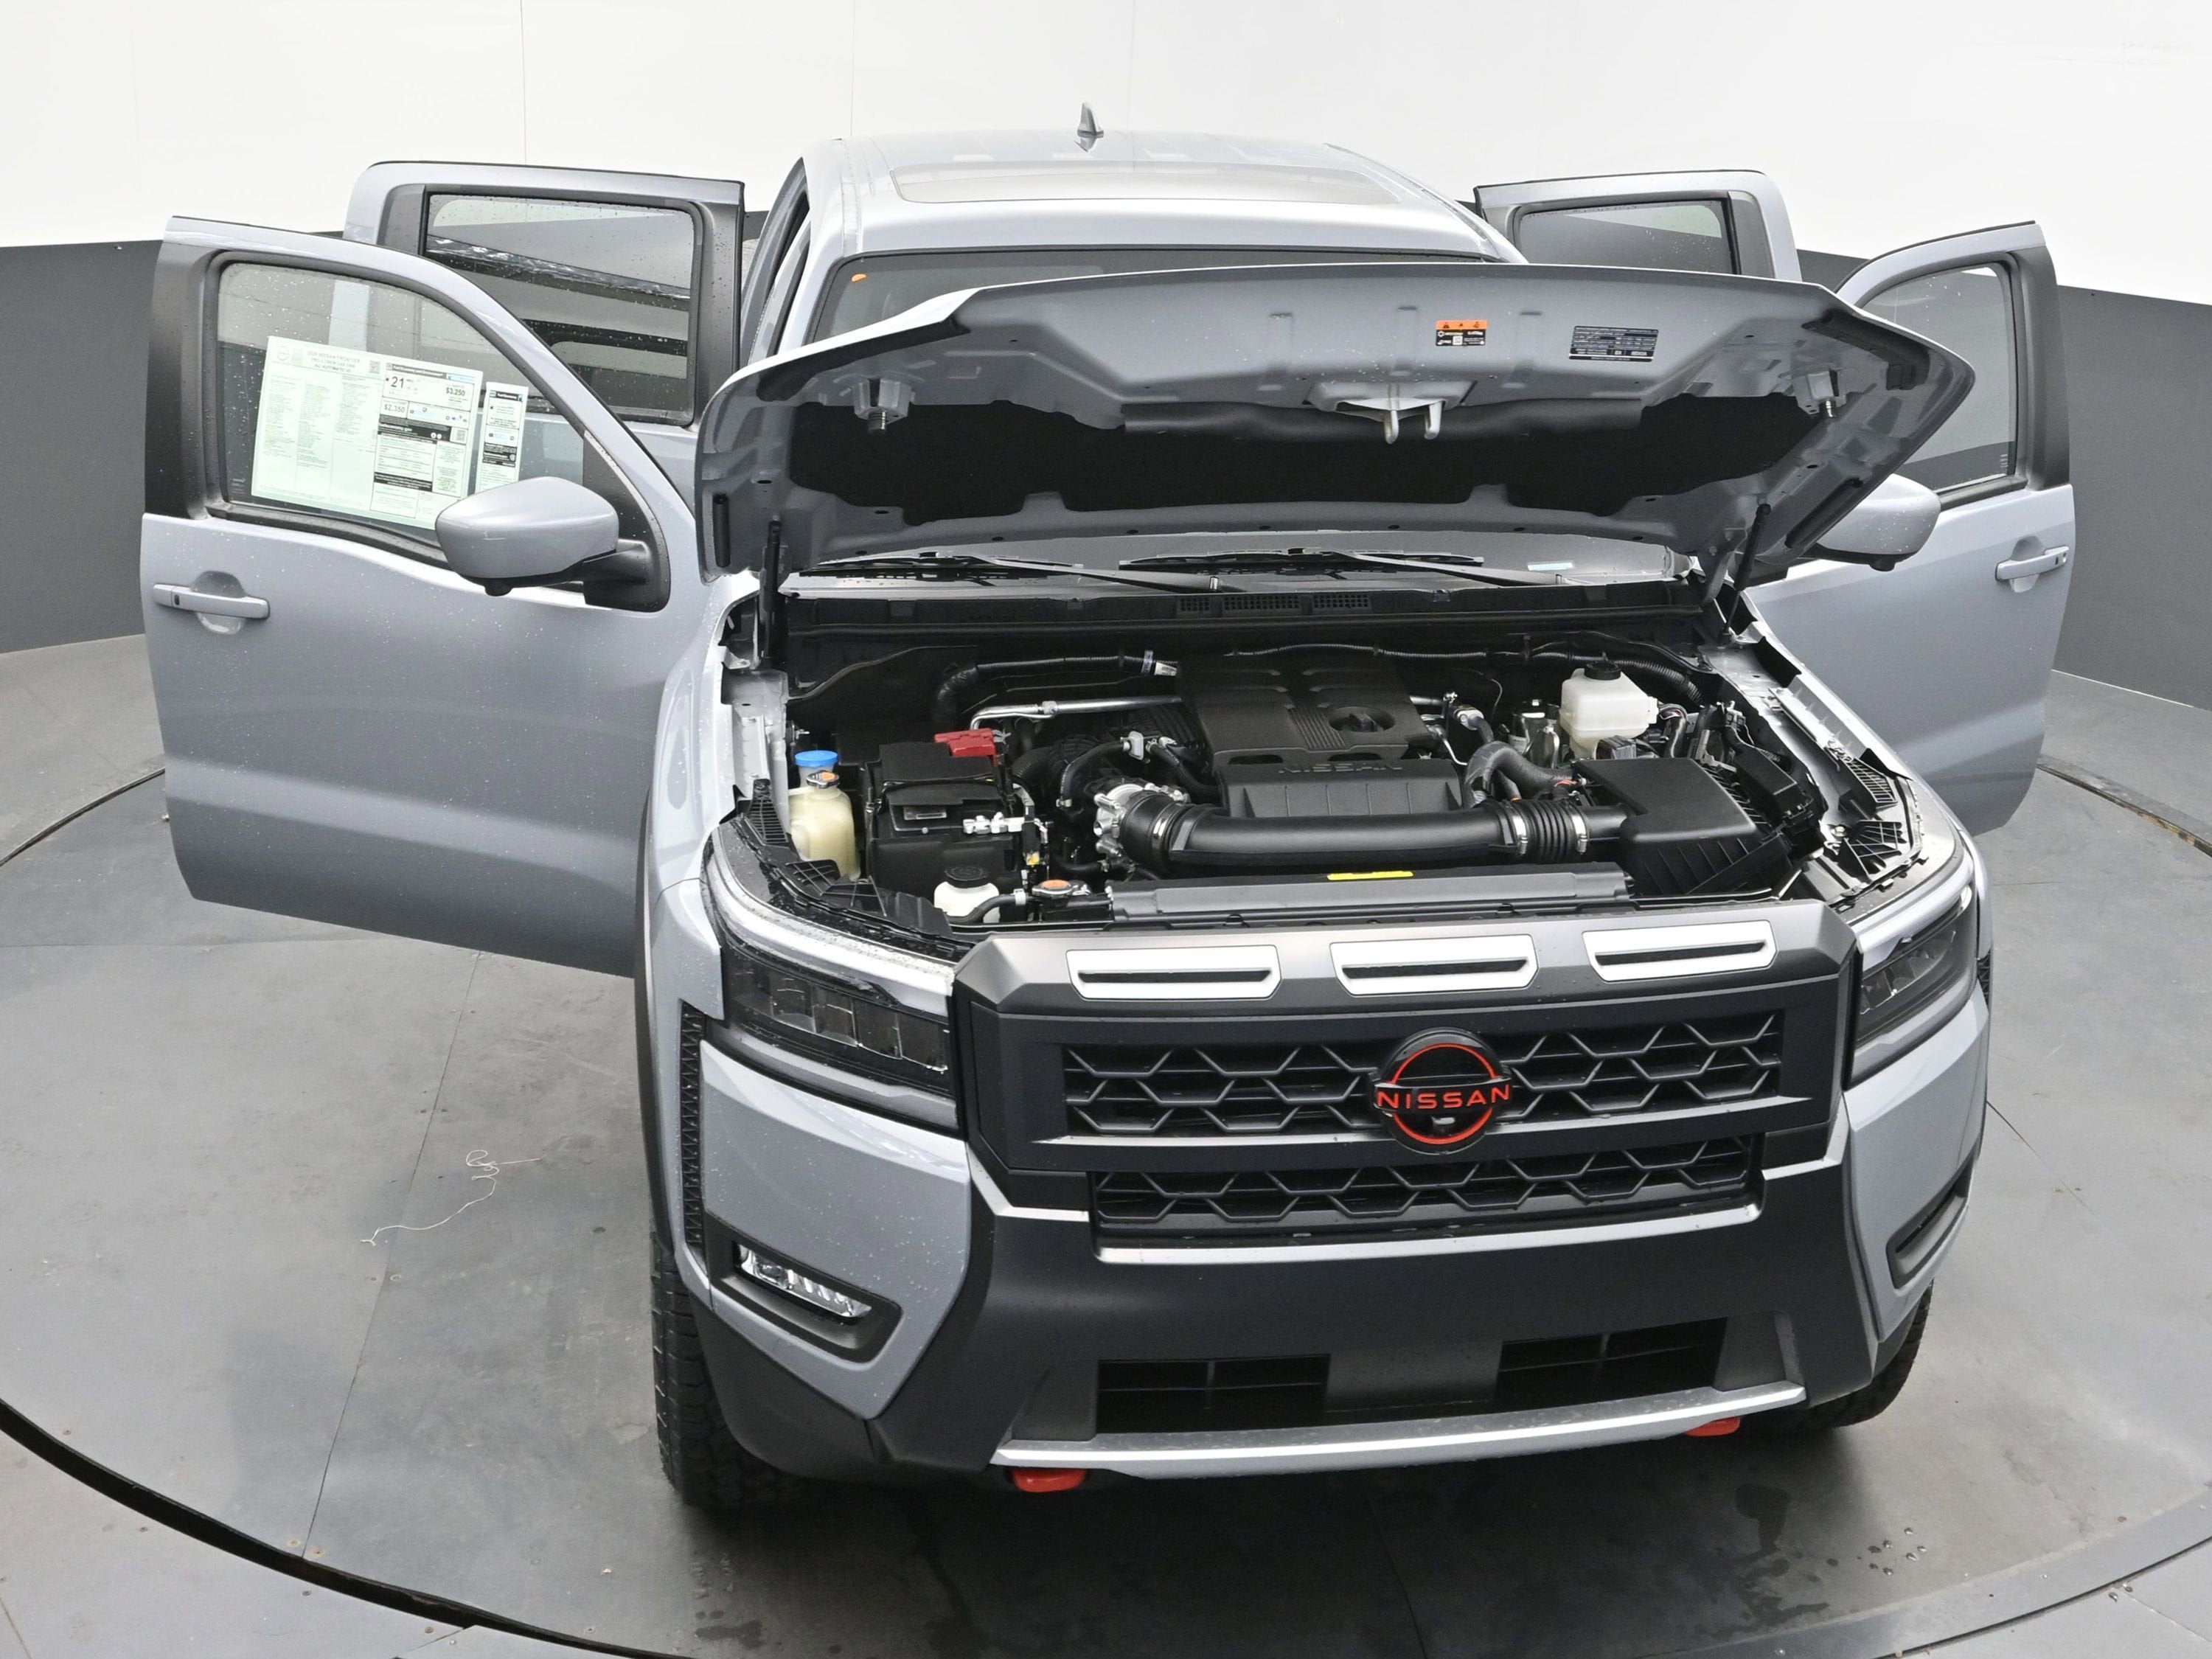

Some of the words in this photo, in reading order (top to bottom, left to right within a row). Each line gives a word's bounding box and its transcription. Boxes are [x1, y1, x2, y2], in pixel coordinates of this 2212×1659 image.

[391, 376, 404, 389] 21
[1279, 762, 1402, 773] NISSAN
[1377, 1085, 1510, 1109] NISSAN
